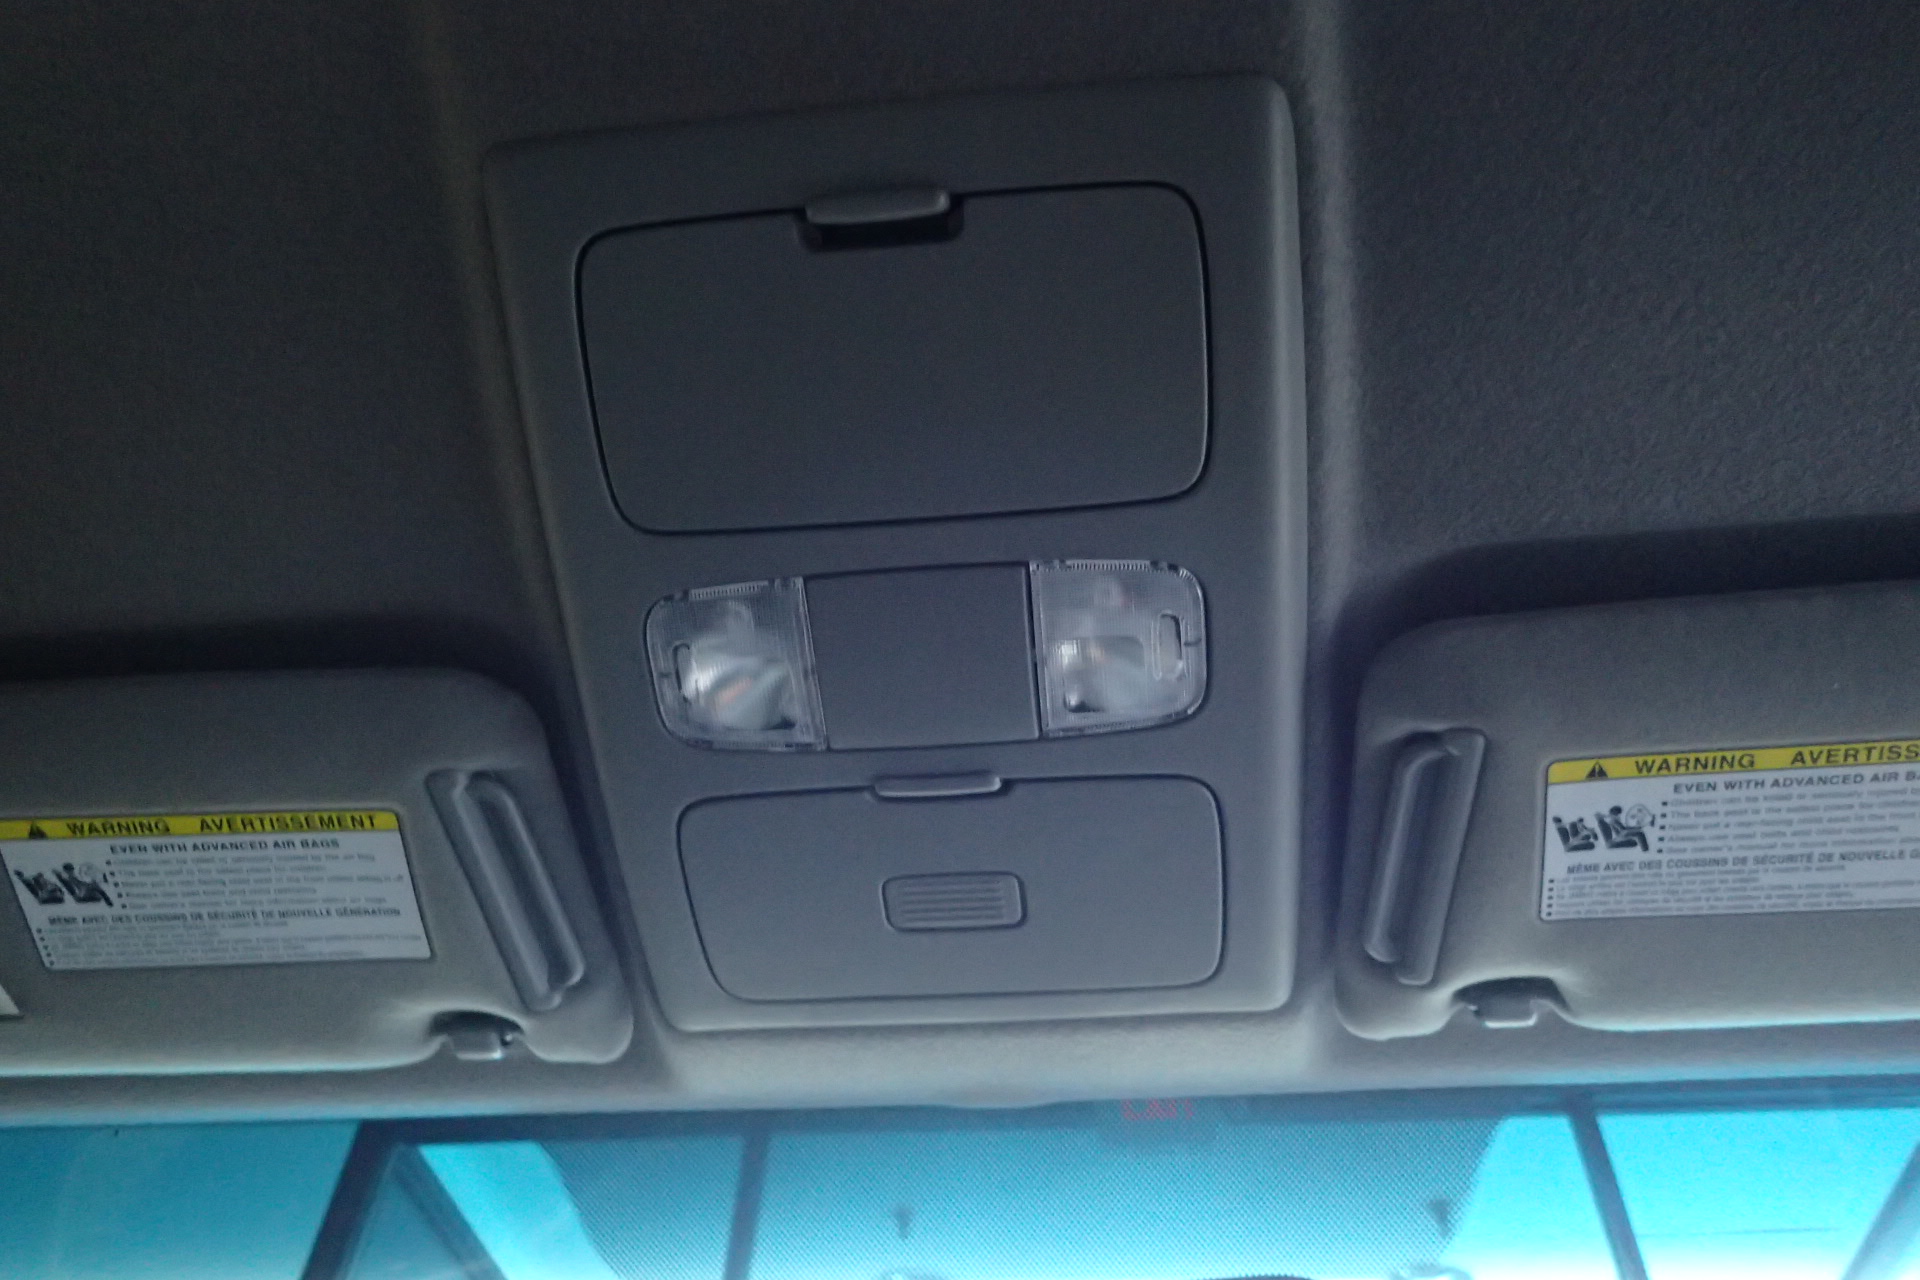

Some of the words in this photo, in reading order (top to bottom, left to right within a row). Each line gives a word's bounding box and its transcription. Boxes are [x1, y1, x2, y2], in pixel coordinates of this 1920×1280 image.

[1635, 753, 1755, 774] WARNING
[1673, 781, 1717, 794] EVEN
[1724, 779, 1765, 791] WITH
[1770, 772, 1865, 788] ADVANCED
[1870, 771, 1899, 783] AIR
[66, 818, 170, 836] WARNING
[200, 814, 376, 832] AVERTISSEMENT
[110, 843, 148, 855] EVEN
[151, 842, 188, 854] WITH
[191, 840, 268, 852] ADVANCED
[272, 838, 296, 849] AIR
[300, 837, 340, 849] BAGS
[1603, 859, 1635, 872] AVEC
[1666, 855, 1728, 869] COUSSINS
